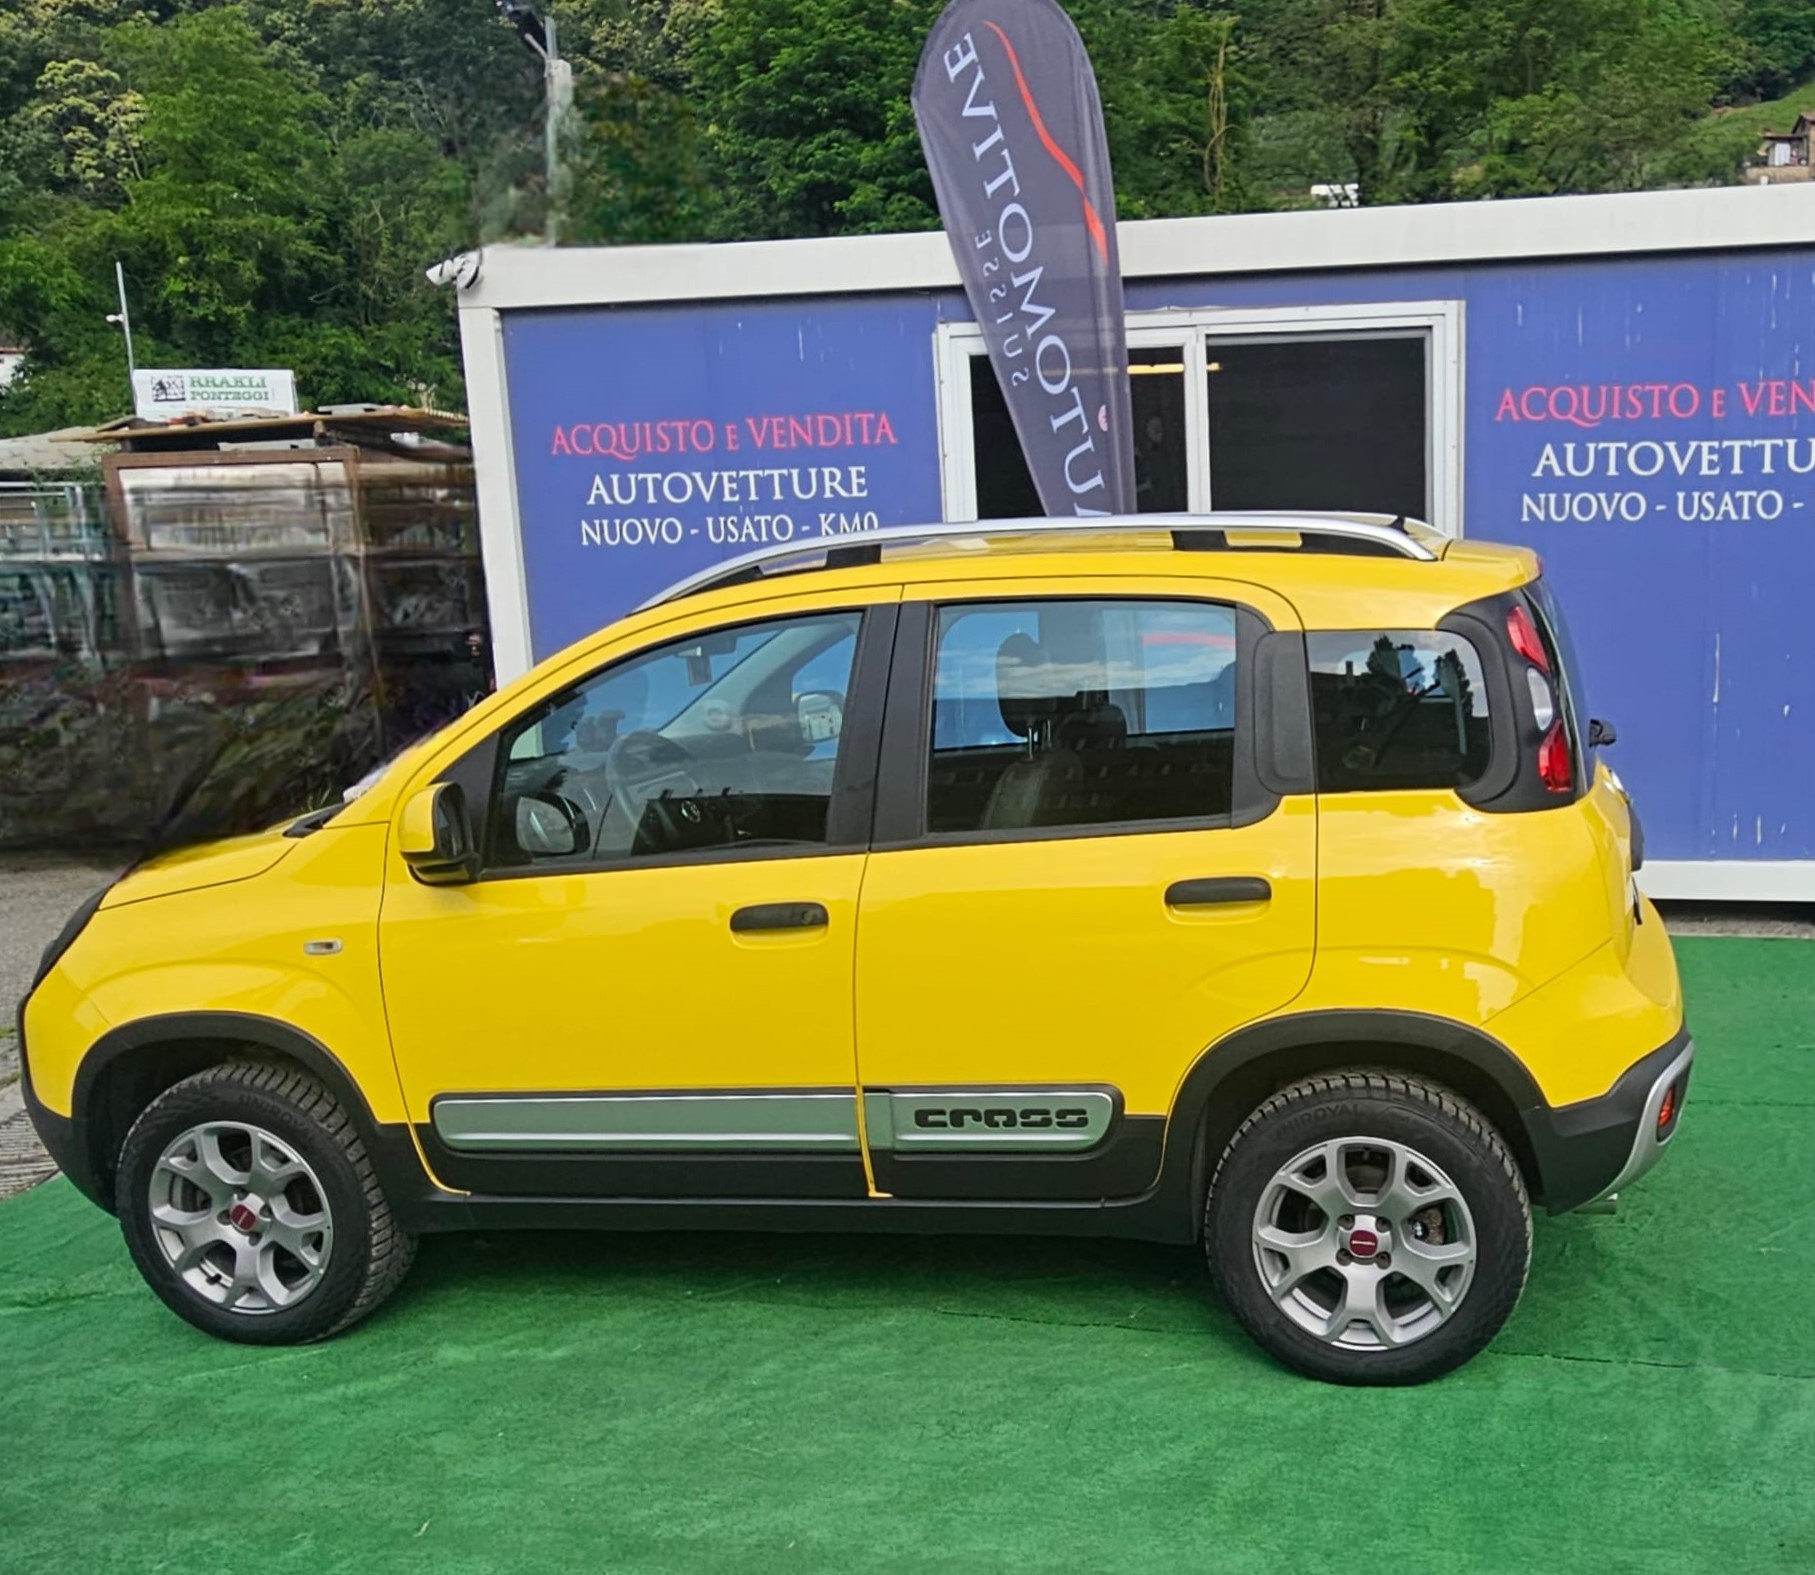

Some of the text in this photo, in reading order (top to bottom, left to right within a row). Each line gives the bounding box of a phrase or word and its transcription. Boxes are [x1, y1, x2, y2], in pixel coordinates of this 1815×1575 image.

[190, 390, 270, 401] PONTEGGI
[1495, 383, 1700, 427] ACQUISTO
[1712, 389, 1725, 417] E
[552, 412, 897, 461] ACQUISTO E VENDITA
[1531, 438, 1815, 477] AUTOVETTU
[586, 466, 868, 505] AUTOVETTURE
[1521, 492, 1647, 522] NUOVO
[1676, 490, 1783, 522] USATO
[581, 517, 683, 546] NUOVO
[705, 513, 794, 543] USATO
[1268, 1103, 1364, 1143] UNIROYAL
